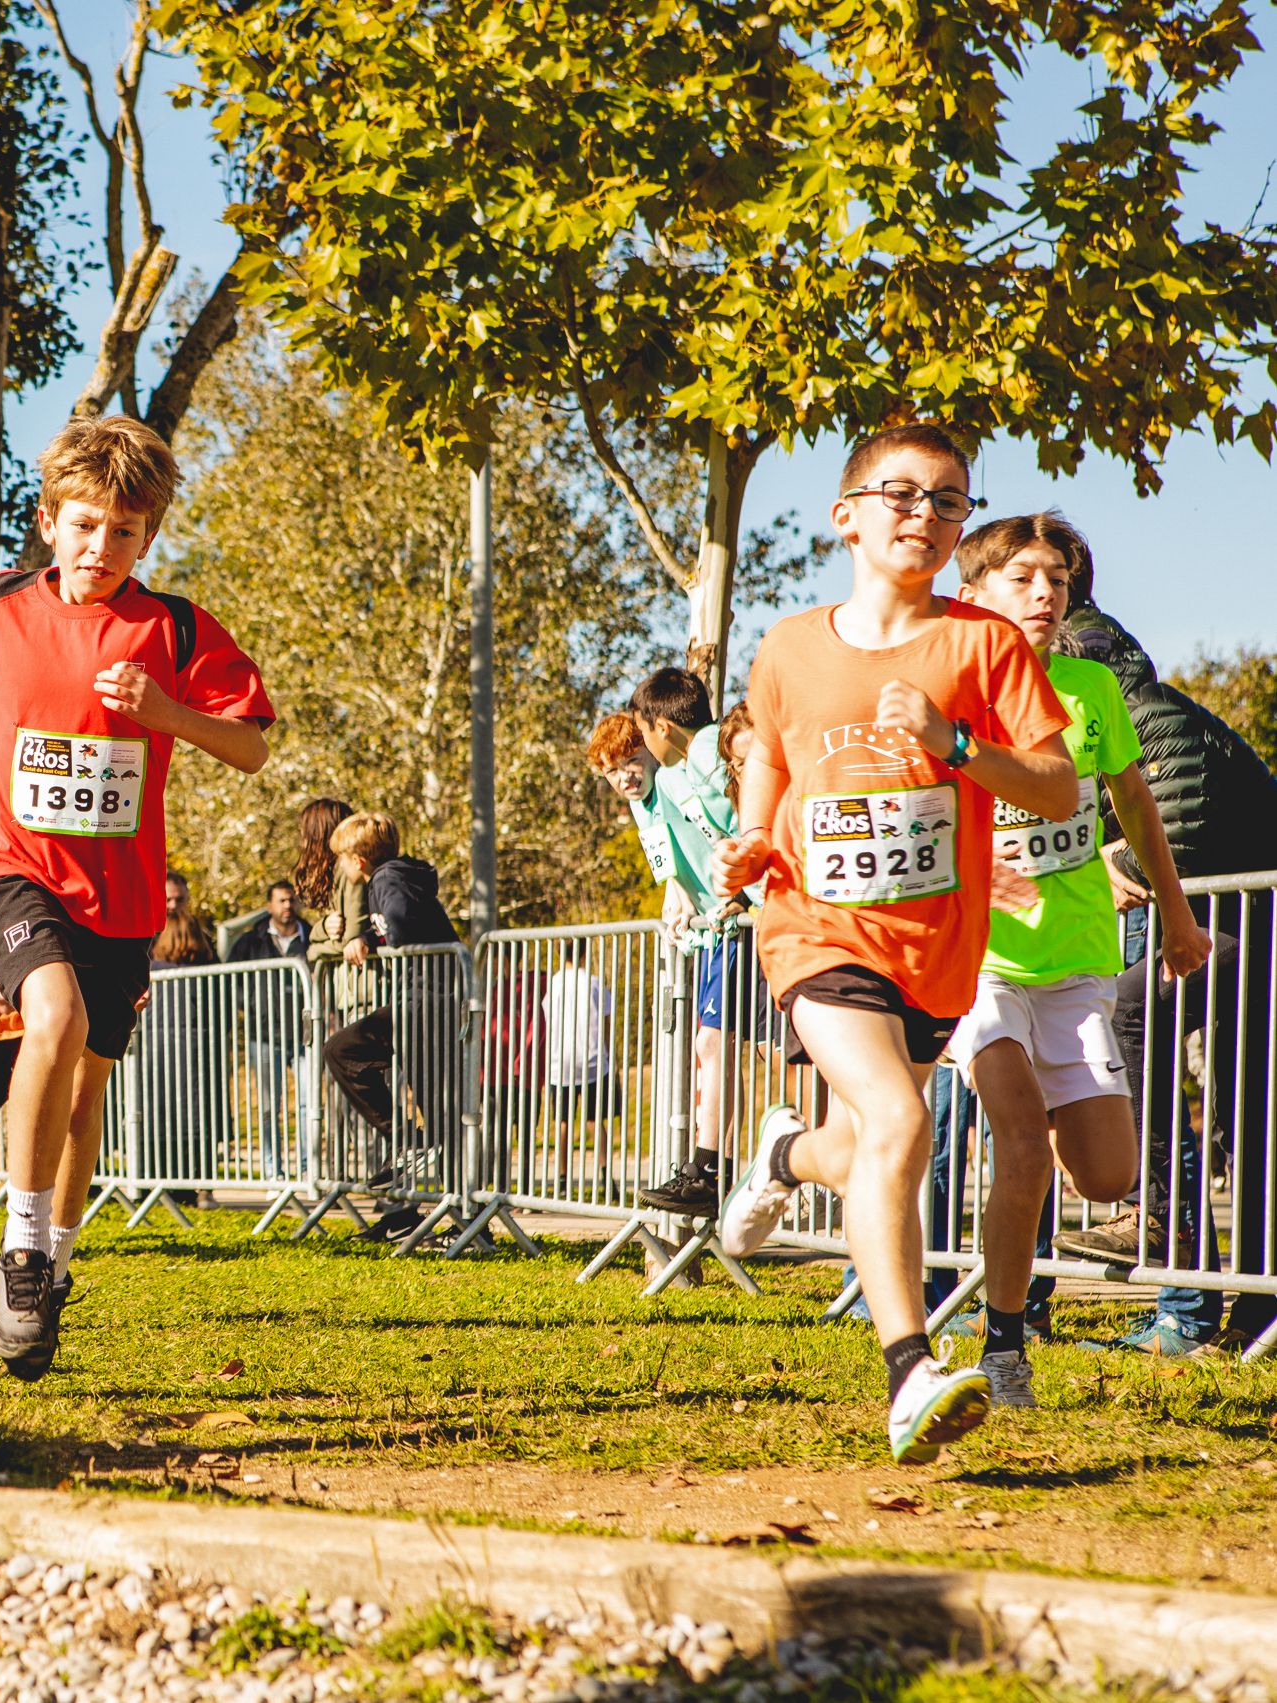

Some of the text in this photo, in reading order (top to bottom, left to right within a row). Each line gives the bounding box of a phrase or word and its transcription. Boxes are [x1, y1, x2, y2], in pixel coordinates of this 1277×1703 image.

[22, 750, 69, 770] CROS
[30, 784, 120, 814] 1398
[813, 814, 871, 834] CROS
[826, 845, 936, 880] 2928
